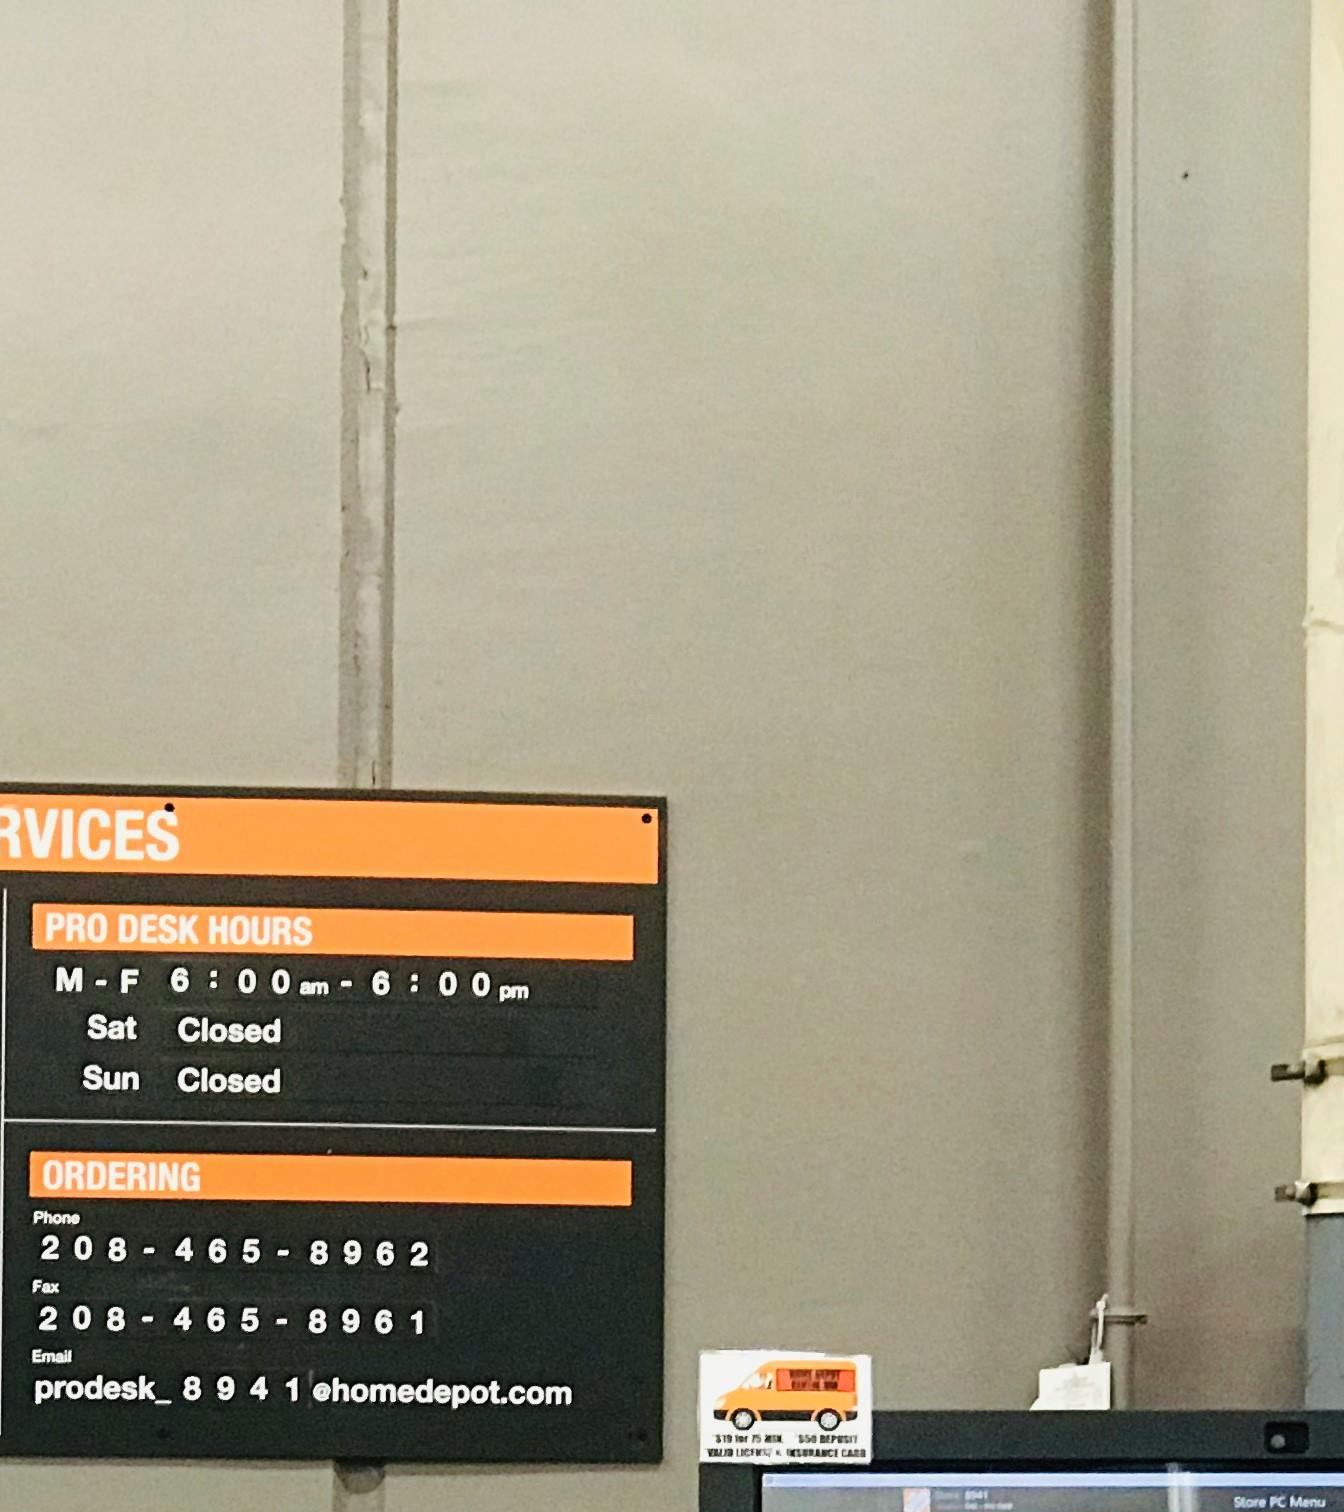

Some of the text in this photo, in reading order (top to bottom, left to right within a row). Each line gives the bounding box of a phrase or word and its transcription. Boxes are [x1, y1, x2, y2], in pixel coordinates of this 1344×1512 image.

[45, 913, 313, 947] PRO DESK HOURS
[87, 1014, 282, 1044] Sat Closed
[82, 1065, 282, 1094] Sun Closed
[43, 1159, 201, 1192] ORDERING
[33, 1211, 80, 1226] Phone
[32, 1280, 59, 1294] Fax
[32, 1349, 73, 1365] Email
[1234, 1496, 1326, 1508] Store PC Menu
